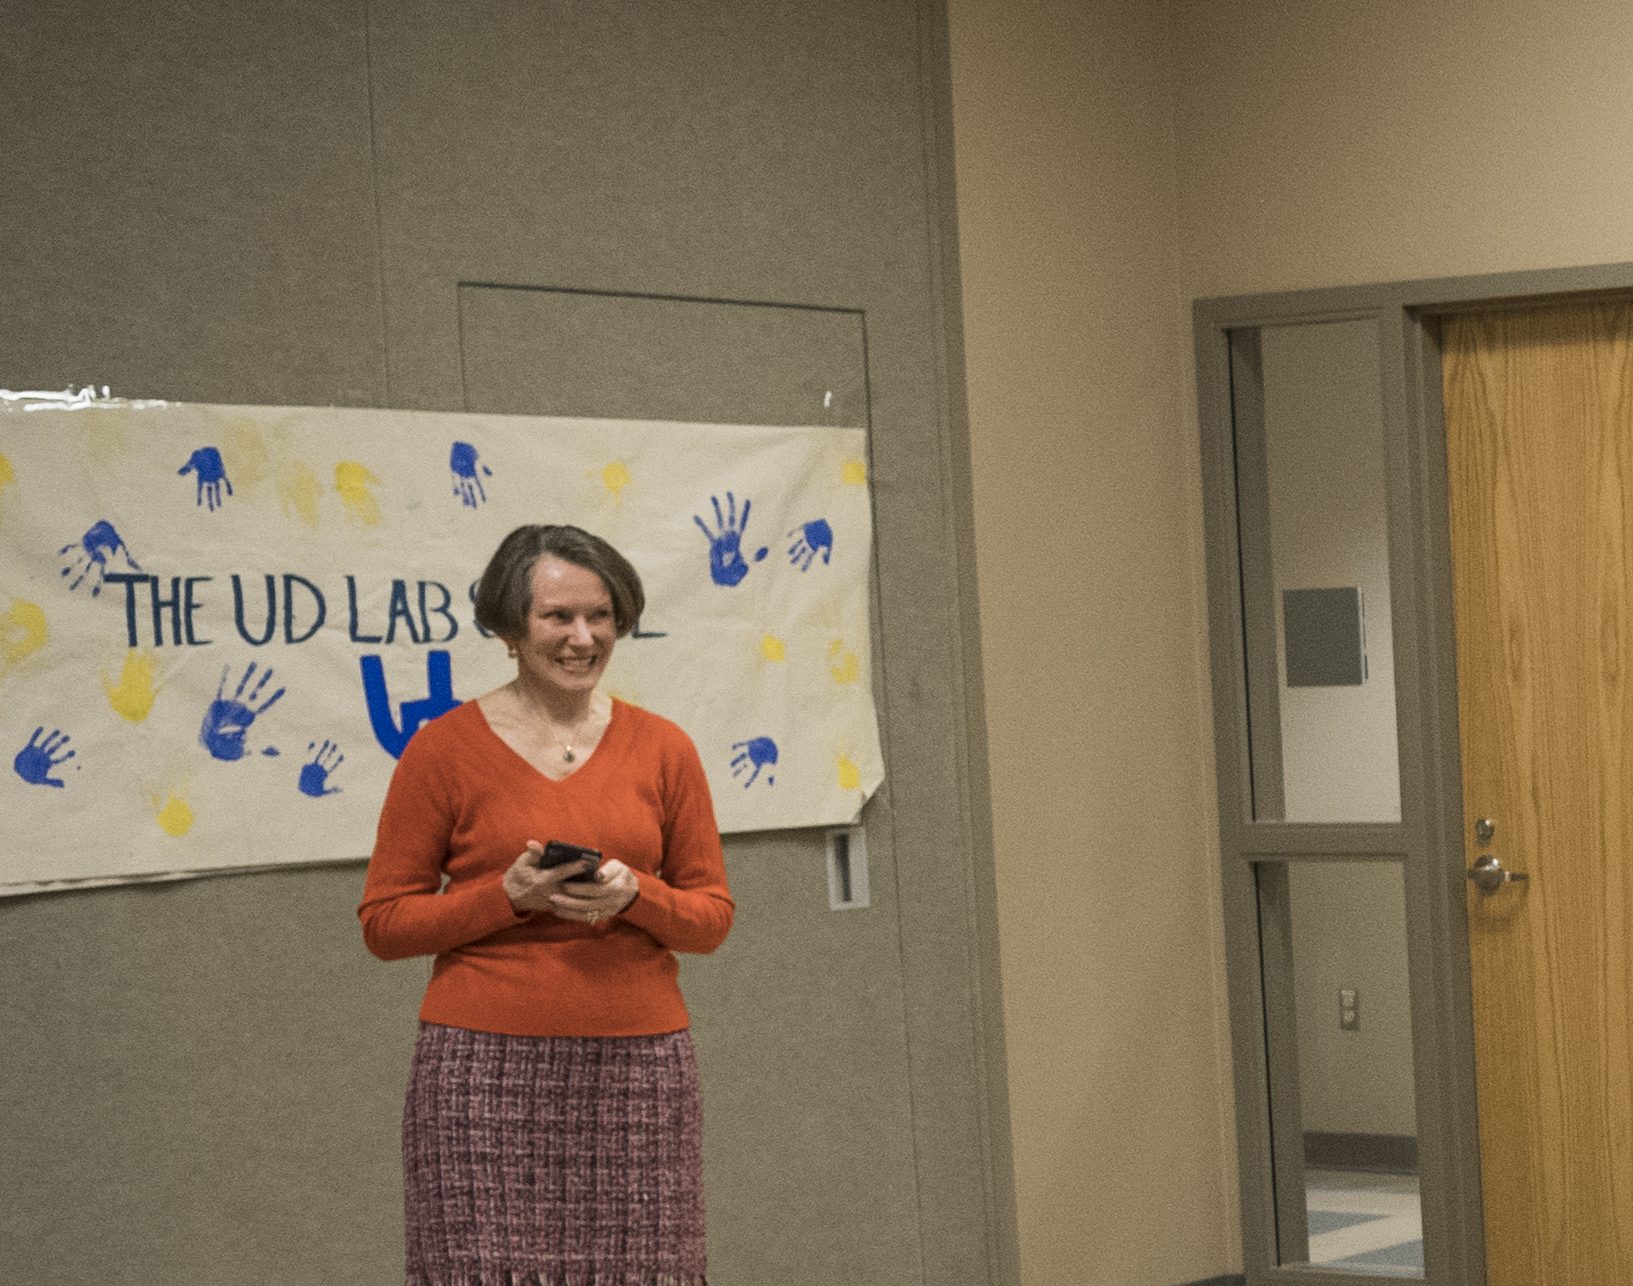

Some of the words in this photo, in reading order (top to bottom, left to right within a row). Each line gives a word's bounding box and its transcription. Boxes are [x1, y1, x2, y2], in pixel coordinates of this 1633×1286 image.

[103, 573, 213, 647] THE
[231, 573, 327, 647] UD
[345, 575, 458, 645] LAB
